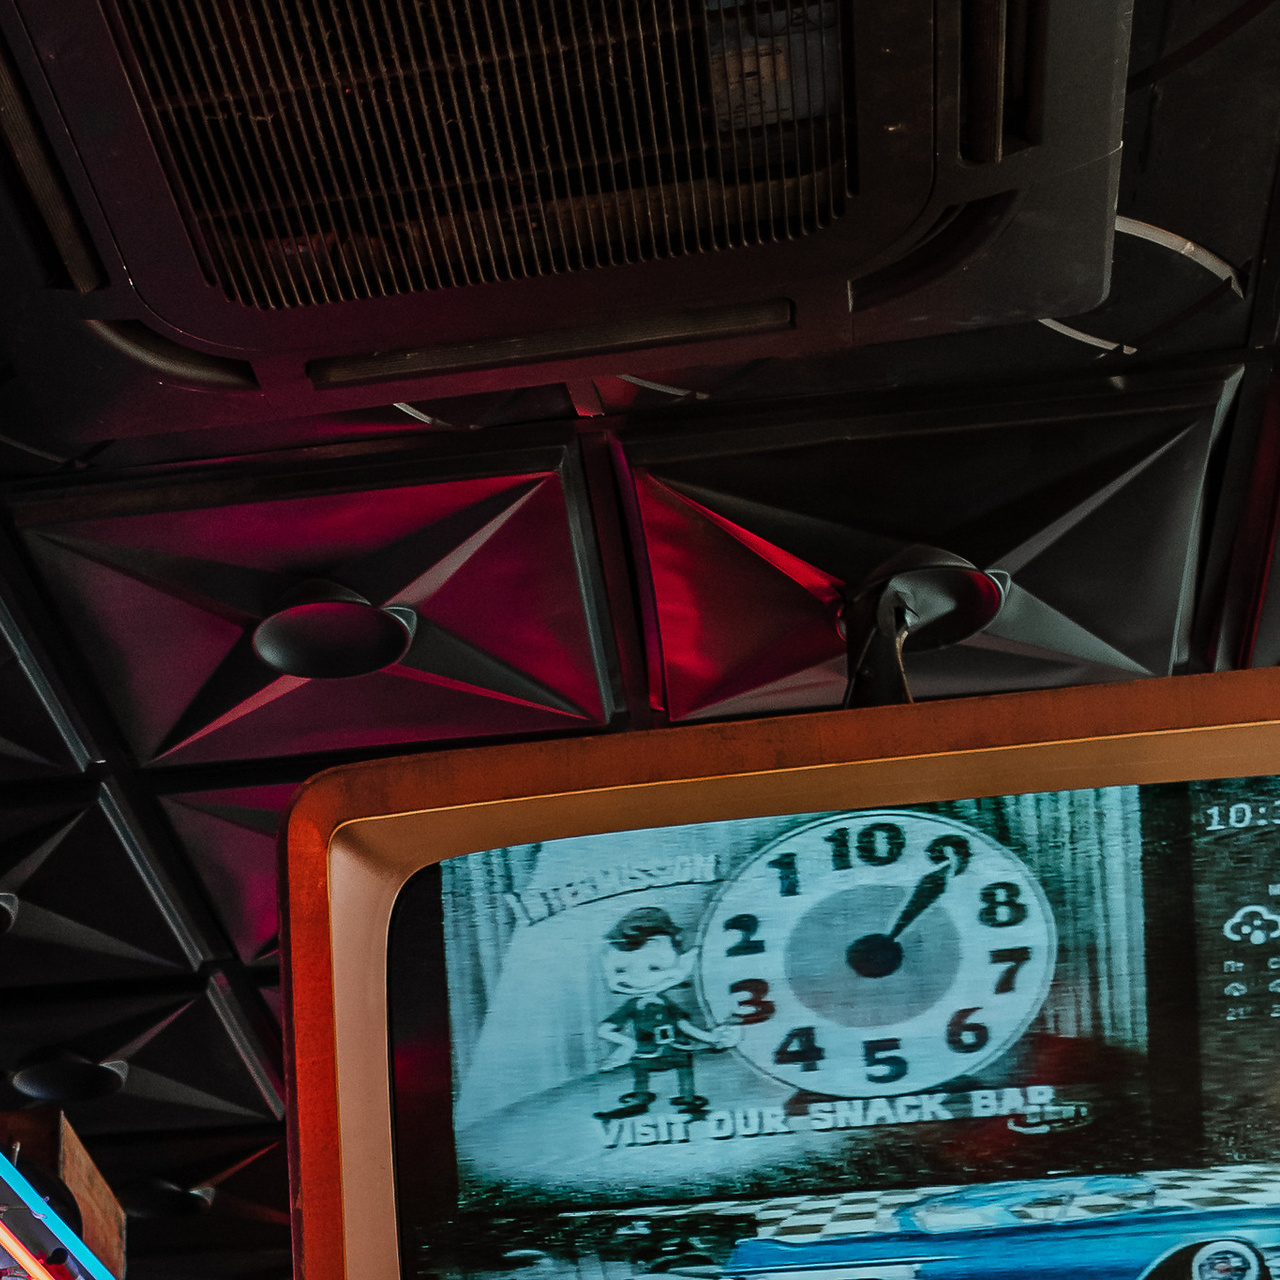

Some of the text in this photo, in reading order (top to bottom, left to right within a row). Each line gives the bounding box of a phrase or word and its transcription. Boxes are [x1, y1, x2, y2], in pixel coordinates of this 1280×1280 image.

[824, 822, 907, 872] 10
[767, 852, 801, 897] 1
[977, 881, 1030, 928] 8
[723, 913, 765, 957] 2
[988, 946, 1032, 994] 7
[728, 978, 776, 1025] 3
[773, 1026, 825, 1072] 4
[945, 1006, 991, 1053] 6
[861, 1037, 908, 1083] 5
[594, 1084, 1058, 1149] VISIT OUR SNACK BAR
